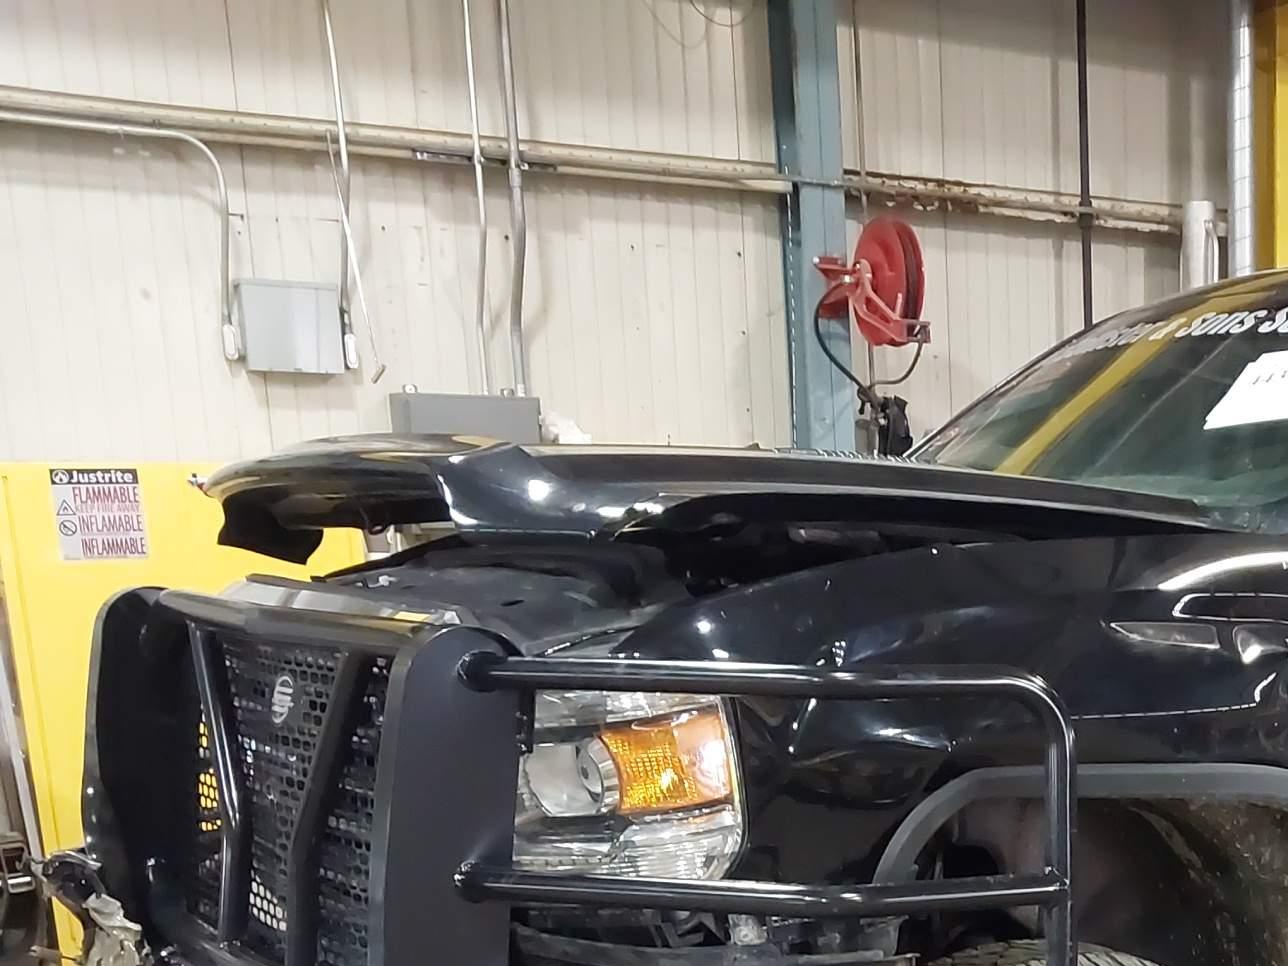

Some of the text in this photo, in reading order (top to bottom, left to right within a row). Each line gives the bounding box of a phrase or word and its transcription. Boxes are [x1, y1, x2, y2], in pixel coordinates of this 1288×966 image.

[70, 470, 134, 483] Justrite
[72, 486, 139, 504] FLAMMABLE
[78, 514, 143, 533] INFLAMABLE
[81, 537, 146, 556] INFLAMMABLE
